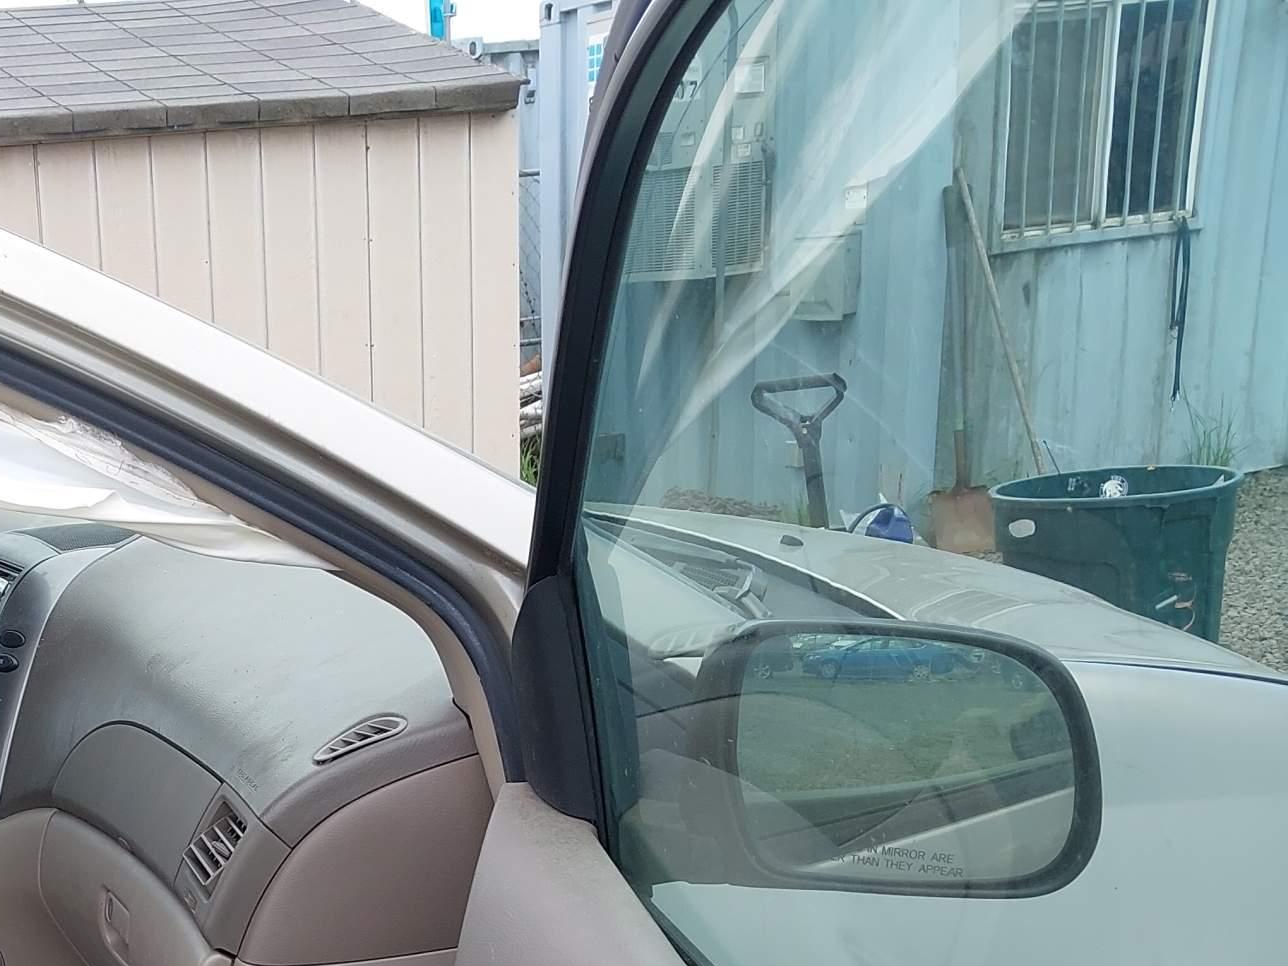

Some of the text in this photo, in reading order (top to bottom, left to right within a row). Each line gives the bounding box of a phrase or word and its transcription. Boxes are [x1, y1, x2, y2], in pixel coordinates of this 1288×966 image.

[881, 845, 926, 860] MIRROR
[931, 851, 955, 864] ARE
[852, 854, 880, 867] THAN
[884, 859, 913, 872] THEY
[918, 863, 964, 878] APPEAR
